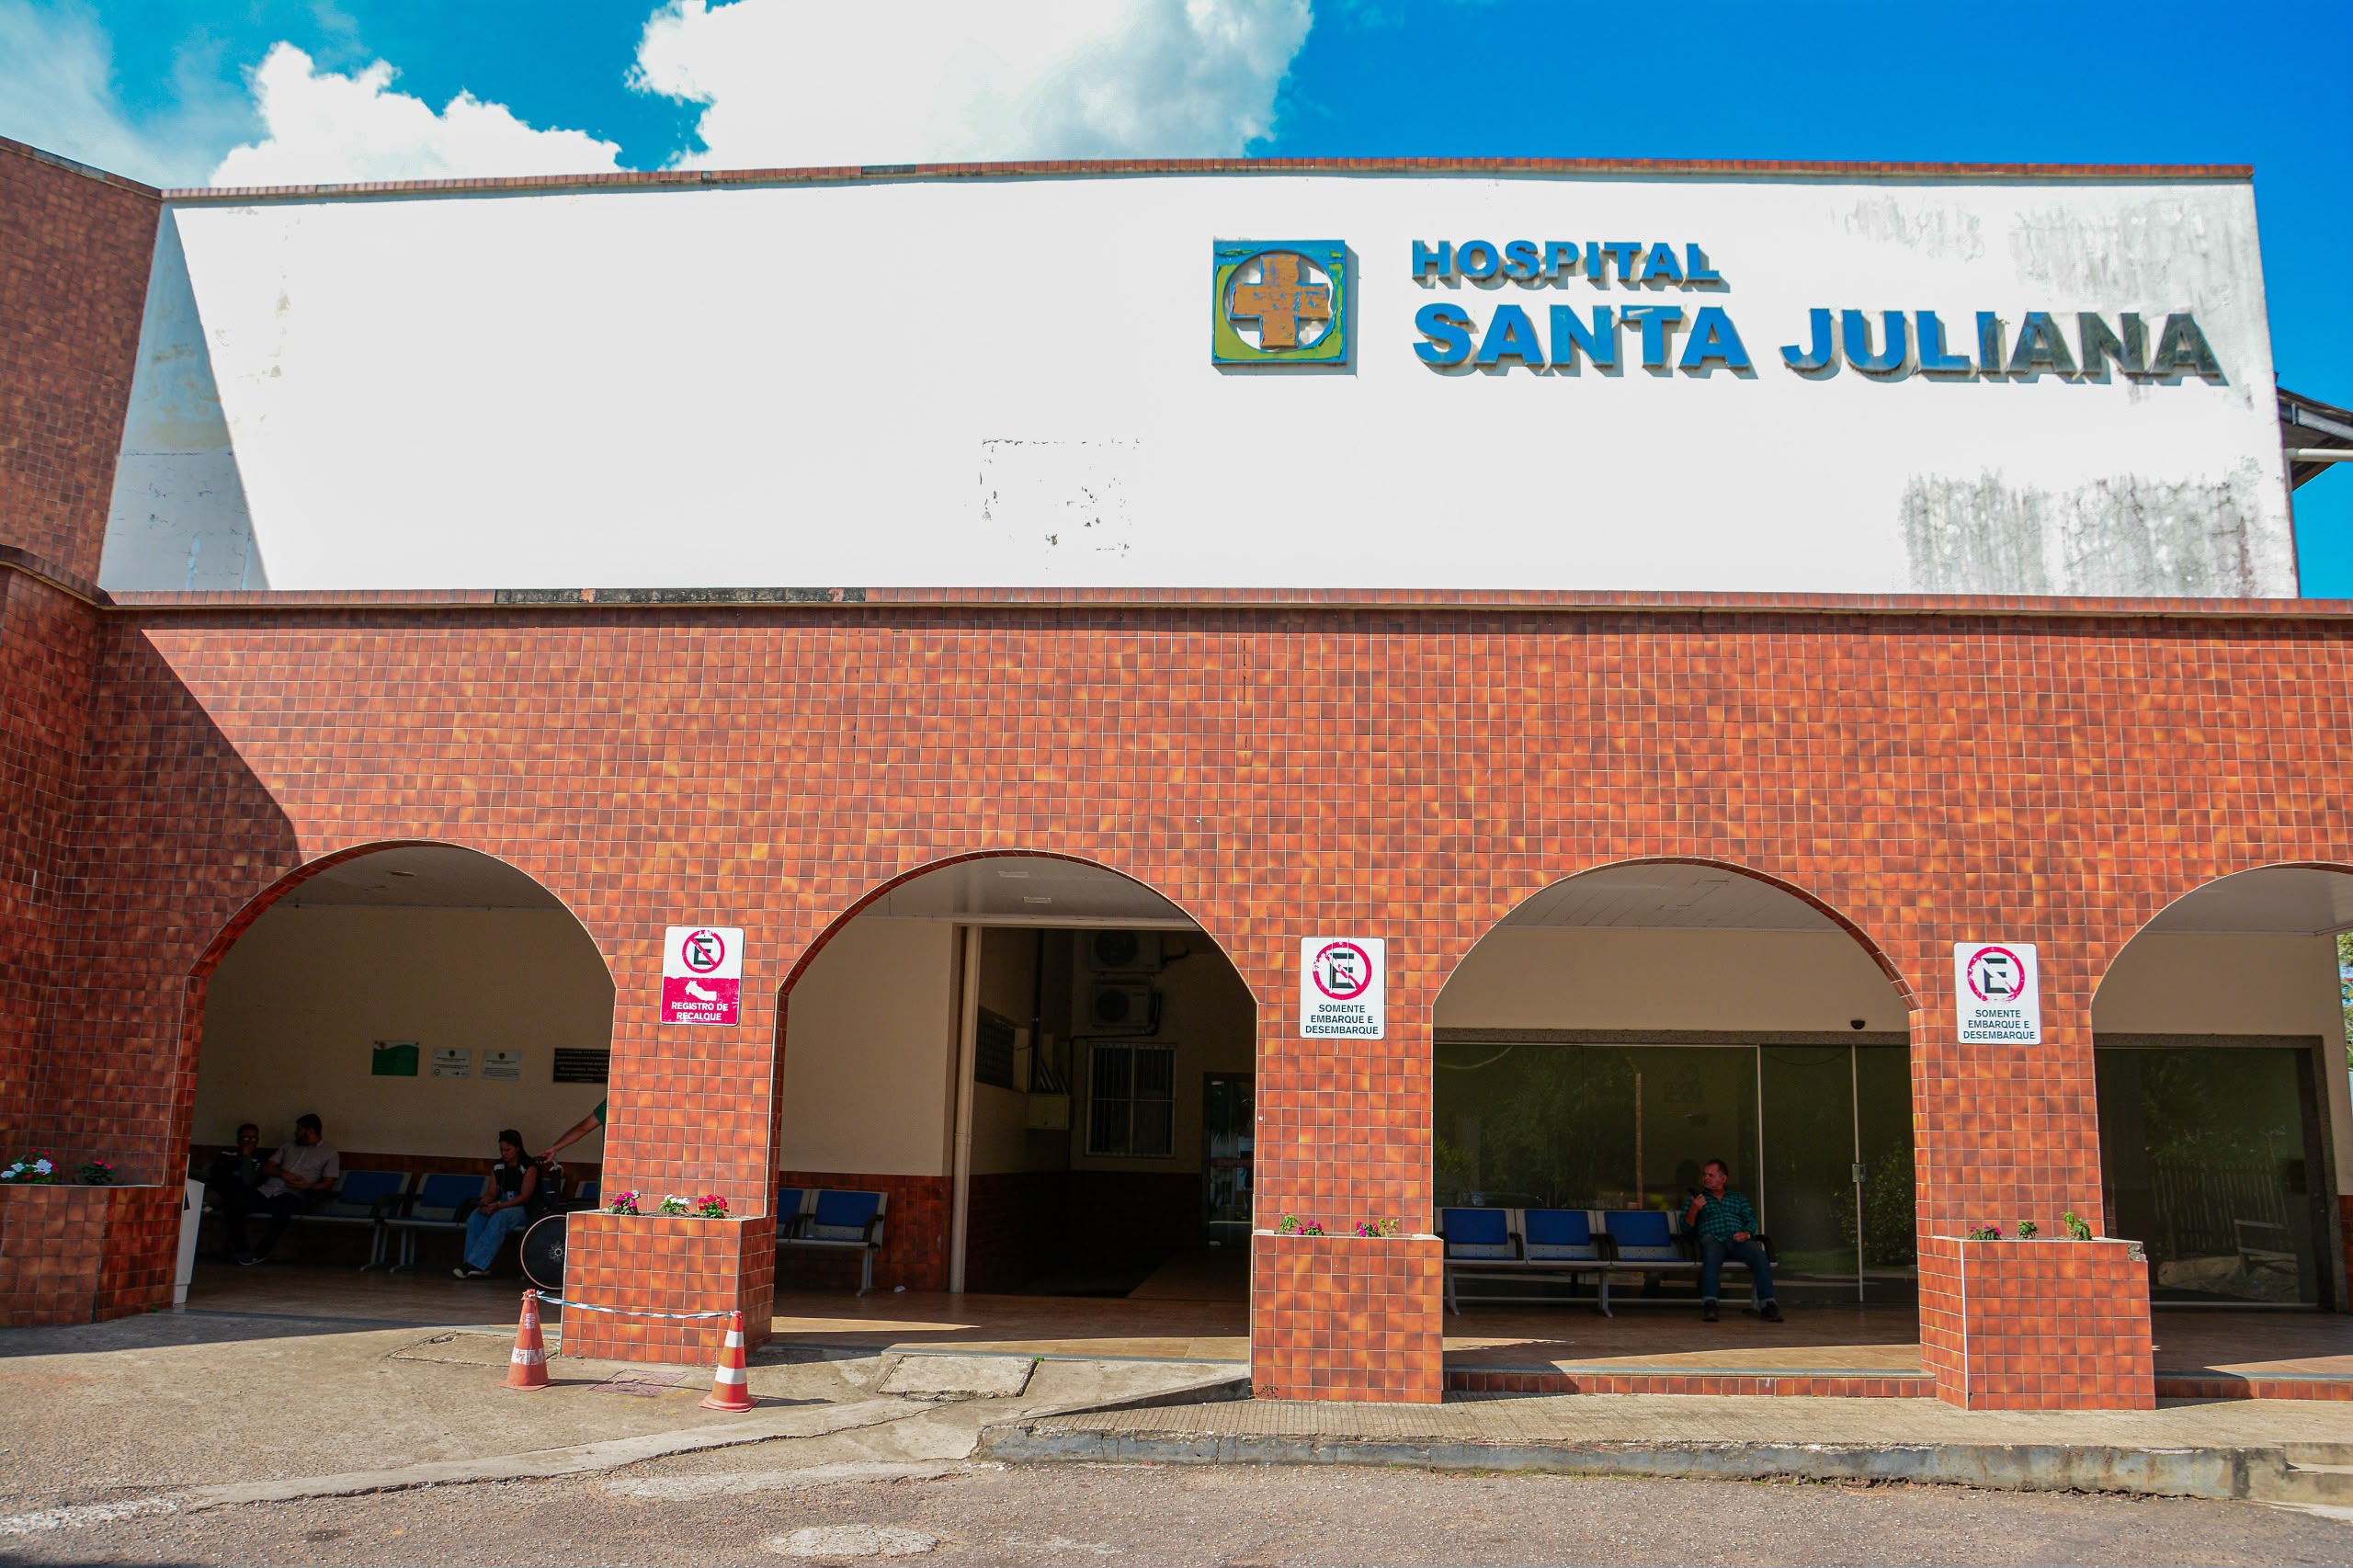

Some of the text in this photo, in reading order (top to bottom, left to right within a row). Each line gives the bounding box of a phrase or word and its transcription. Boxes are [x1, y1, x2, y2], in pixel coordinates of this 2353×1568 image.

[1412, 239, 1722, 282] HOSPITAL
[1412, 302, 2222, 379] SANTA JULIANA
[671, 1001, 729, 1012] REGISTRO DE
[1318, 1004, 1366, 1013] SOMENTE
[676, 1011, 722, 1021] RECALQUE
[1975, 1009, 2021, 1018] SOMENTE
[1311, 1015, 1374, 1024] EMBARQUE E
[1968, 1019, 2030, 1029] EMBARQUE E
[1305, 1025, 1379, 1035] DESEMBARQUE
[1963, 1030, 2036, 1040] DESEMBARQUE
